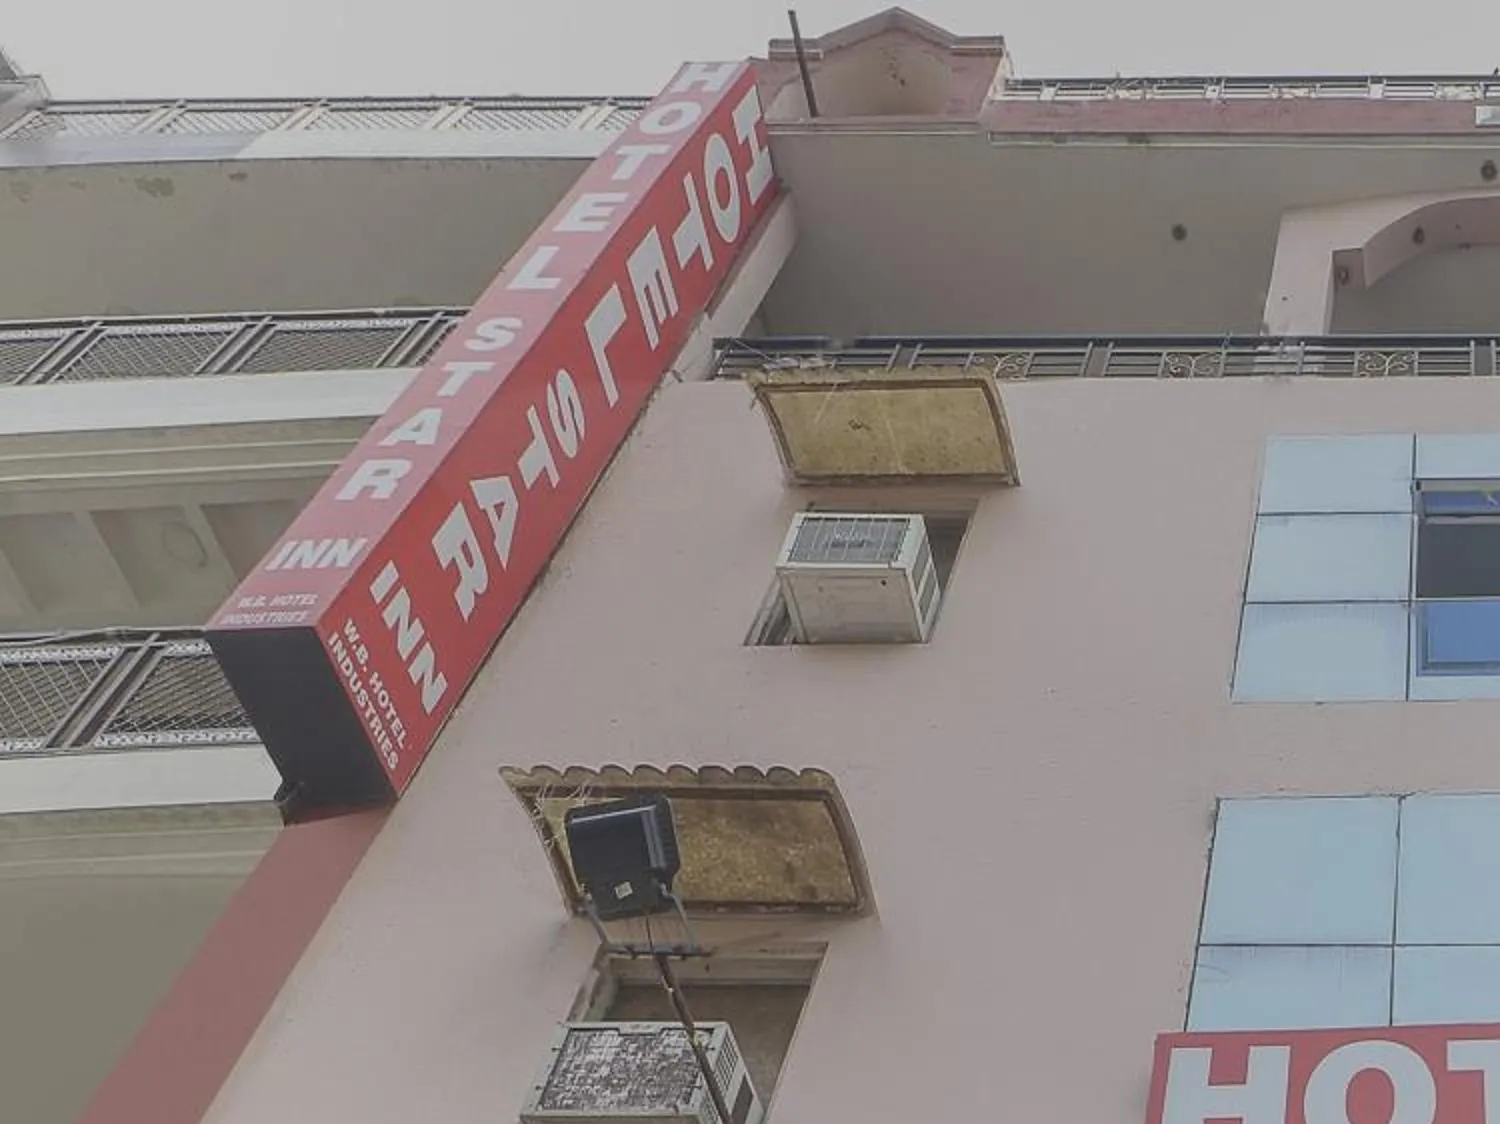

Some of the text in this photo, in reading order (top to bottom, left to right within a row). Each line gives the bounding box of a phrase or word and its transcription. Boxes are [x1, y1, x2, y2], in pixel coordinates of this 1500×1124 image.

[335, 62, 743, 500] HOTEL STAR
[432, 84, 774, 623] HOTEL STAR
[265, 537, 368, 571] INN
[269, 593, 319, 607] HOTEL
[327, 632, 398, 769] INDUSTRIES
[344, 618, 407, 749] W.B. HOTEL
[370, 560, 448, 715] INN
